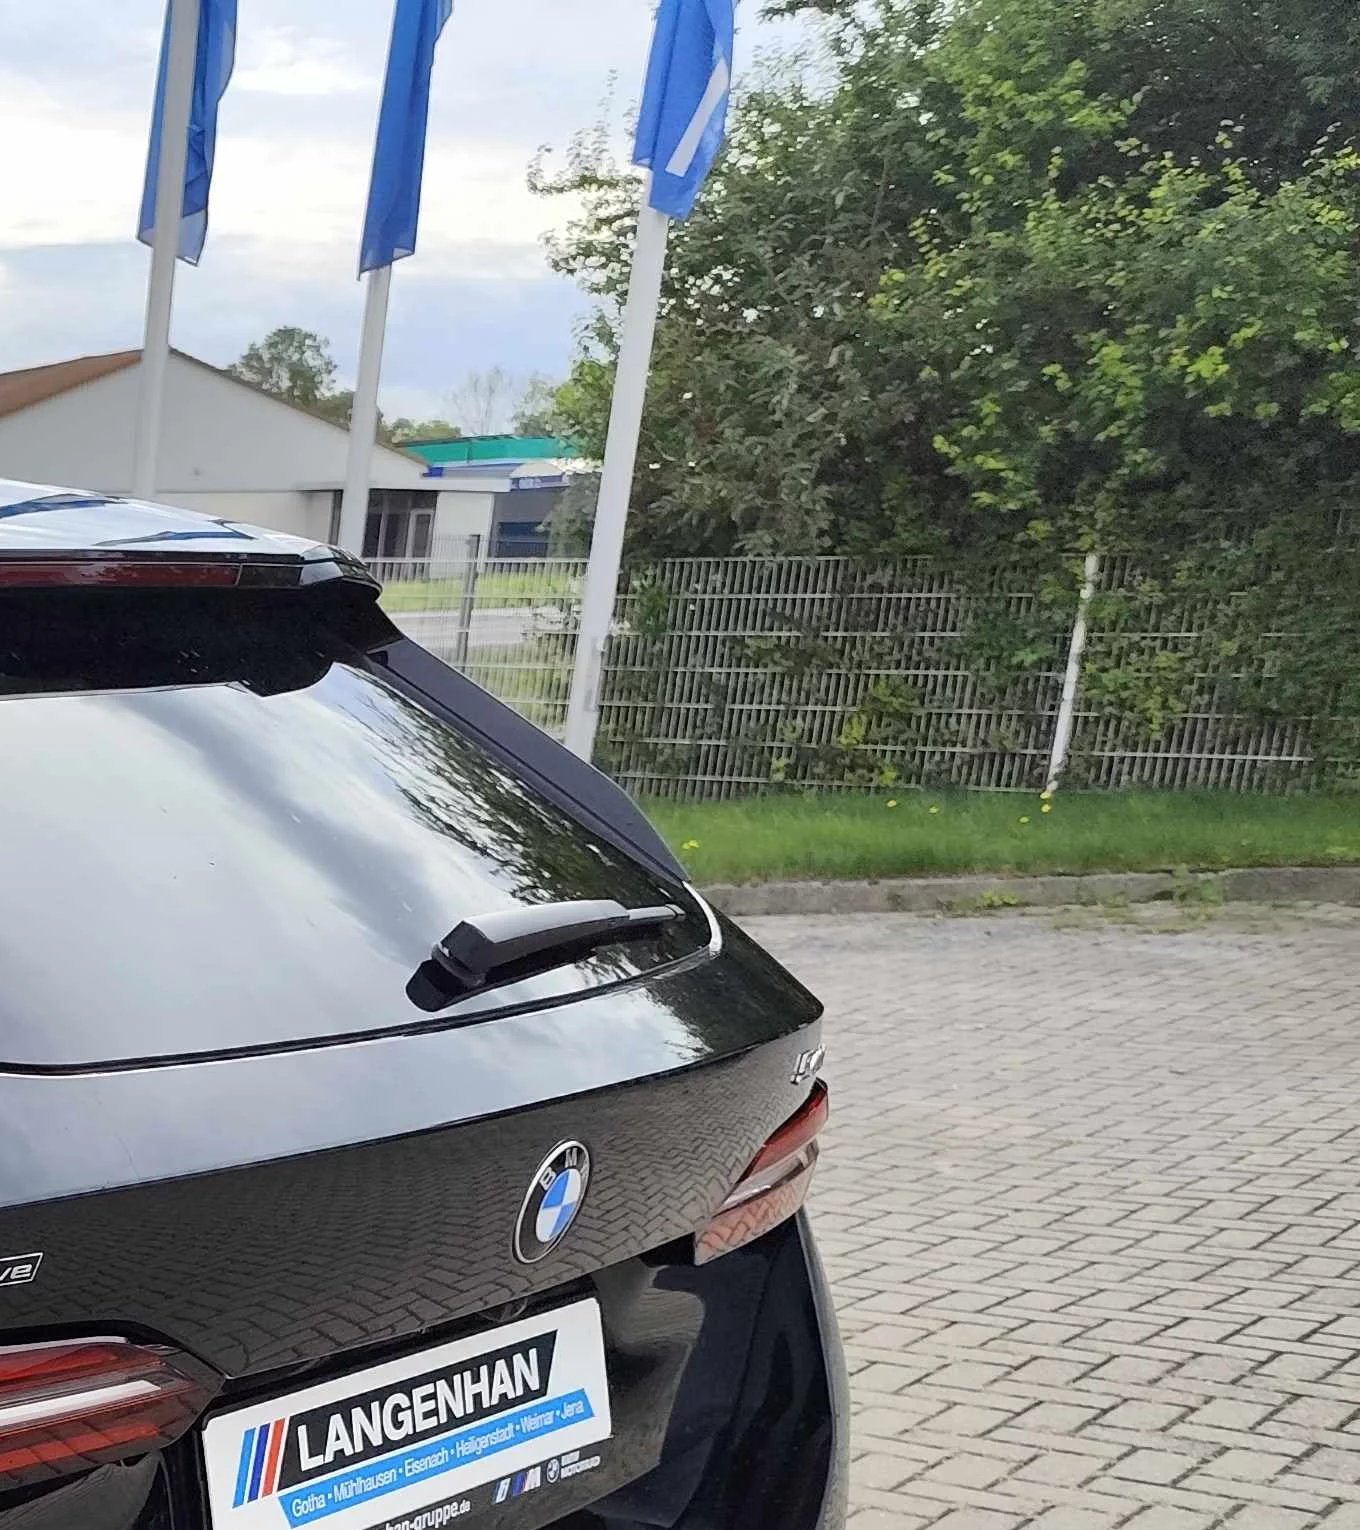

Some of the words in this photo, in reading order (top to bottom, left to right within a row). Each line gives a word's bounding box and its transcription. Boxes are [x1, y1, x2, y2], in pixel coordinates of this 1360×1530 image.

[291, 1492, 327, 1518] Gotha
[333, 1467, 398, 1504] Mühlhausen
[403, 1447, 450, 1478] Eisenach
[455, 1422, 516, 1459] Heiligenstadt
[520, 1409, 556, 1435] Weimar
[560, 1399, 585, 1421] Jena
[297, 1347, 541, 1473] LANGENHAN
